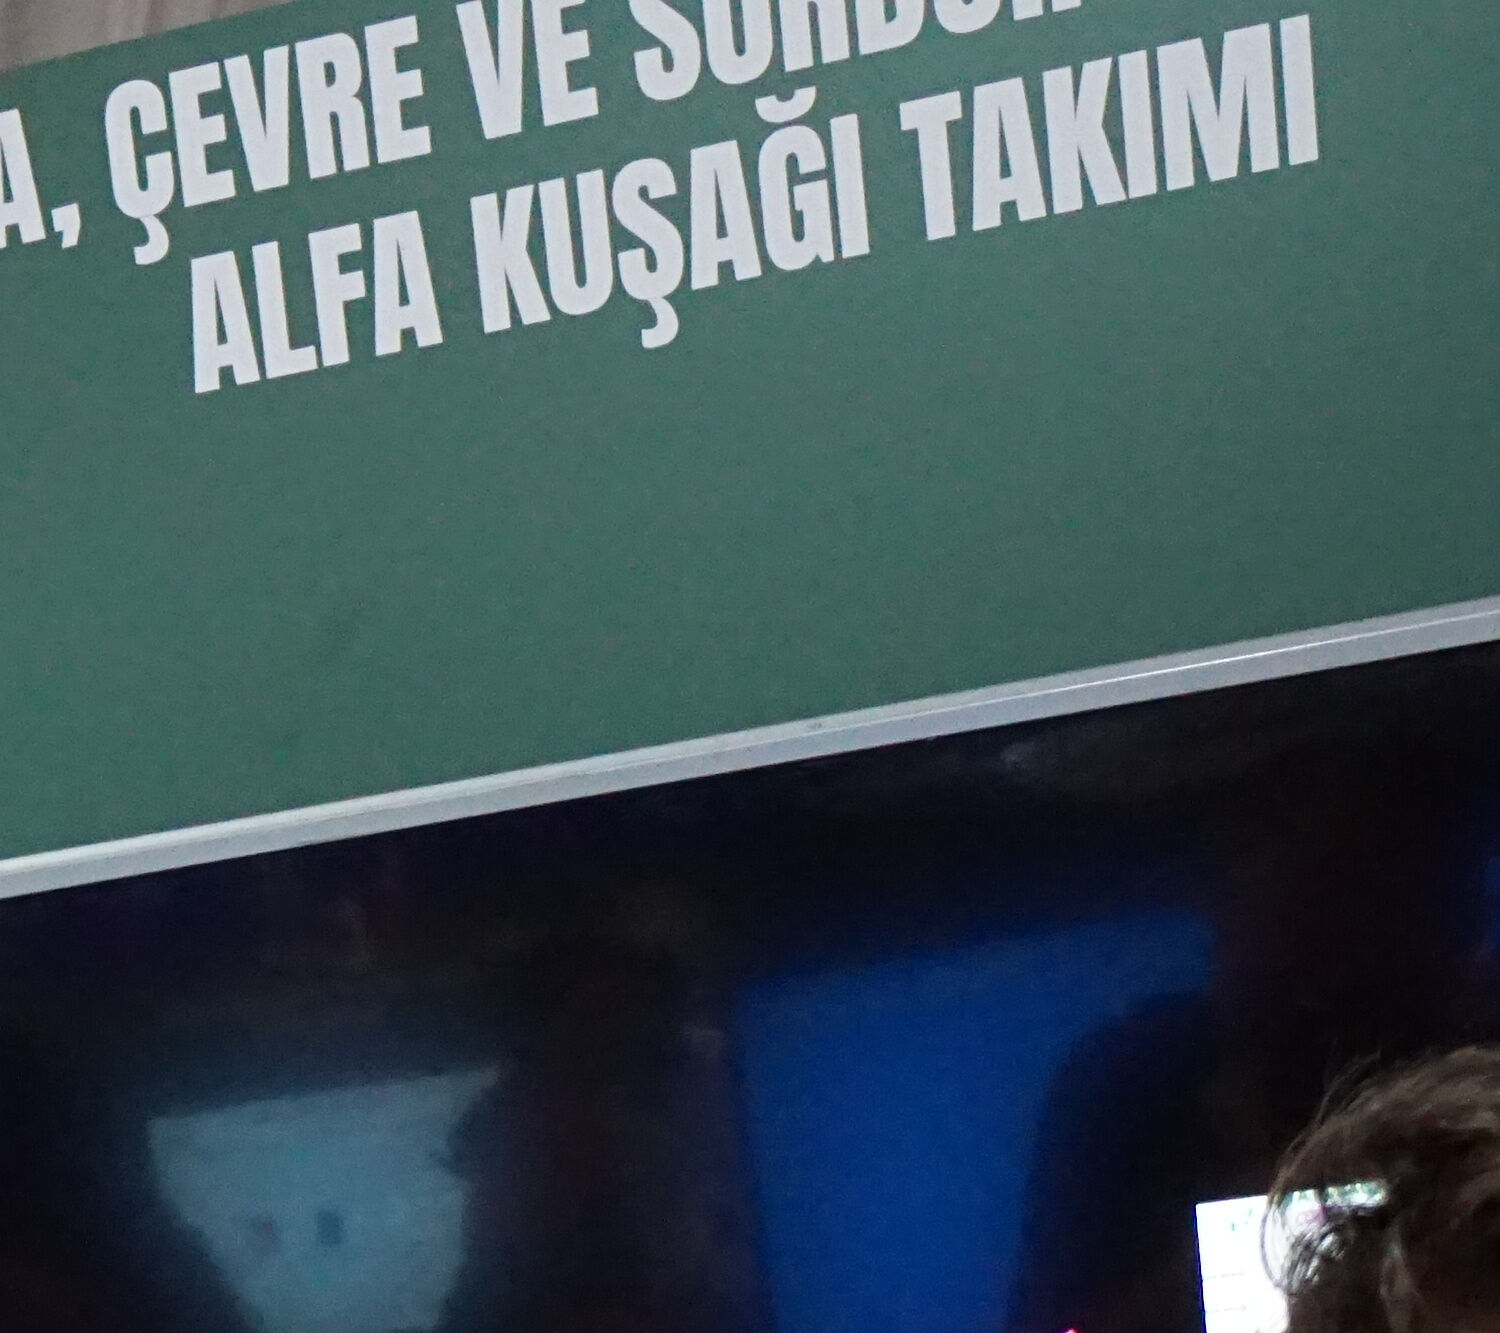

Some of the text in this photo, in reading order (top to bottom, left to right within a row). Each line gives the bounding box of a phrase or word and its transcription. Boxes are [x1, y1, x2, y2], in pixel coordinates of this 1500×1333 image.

[104, 15, 432, 266] ÇEVRE
[455, 0, 598, 141] VE
[190, 210, 443, 394] ALFA
[470, 86, 869, 350] KUŞAĞI
[899, 13, 1320, 241] TAKIMI
